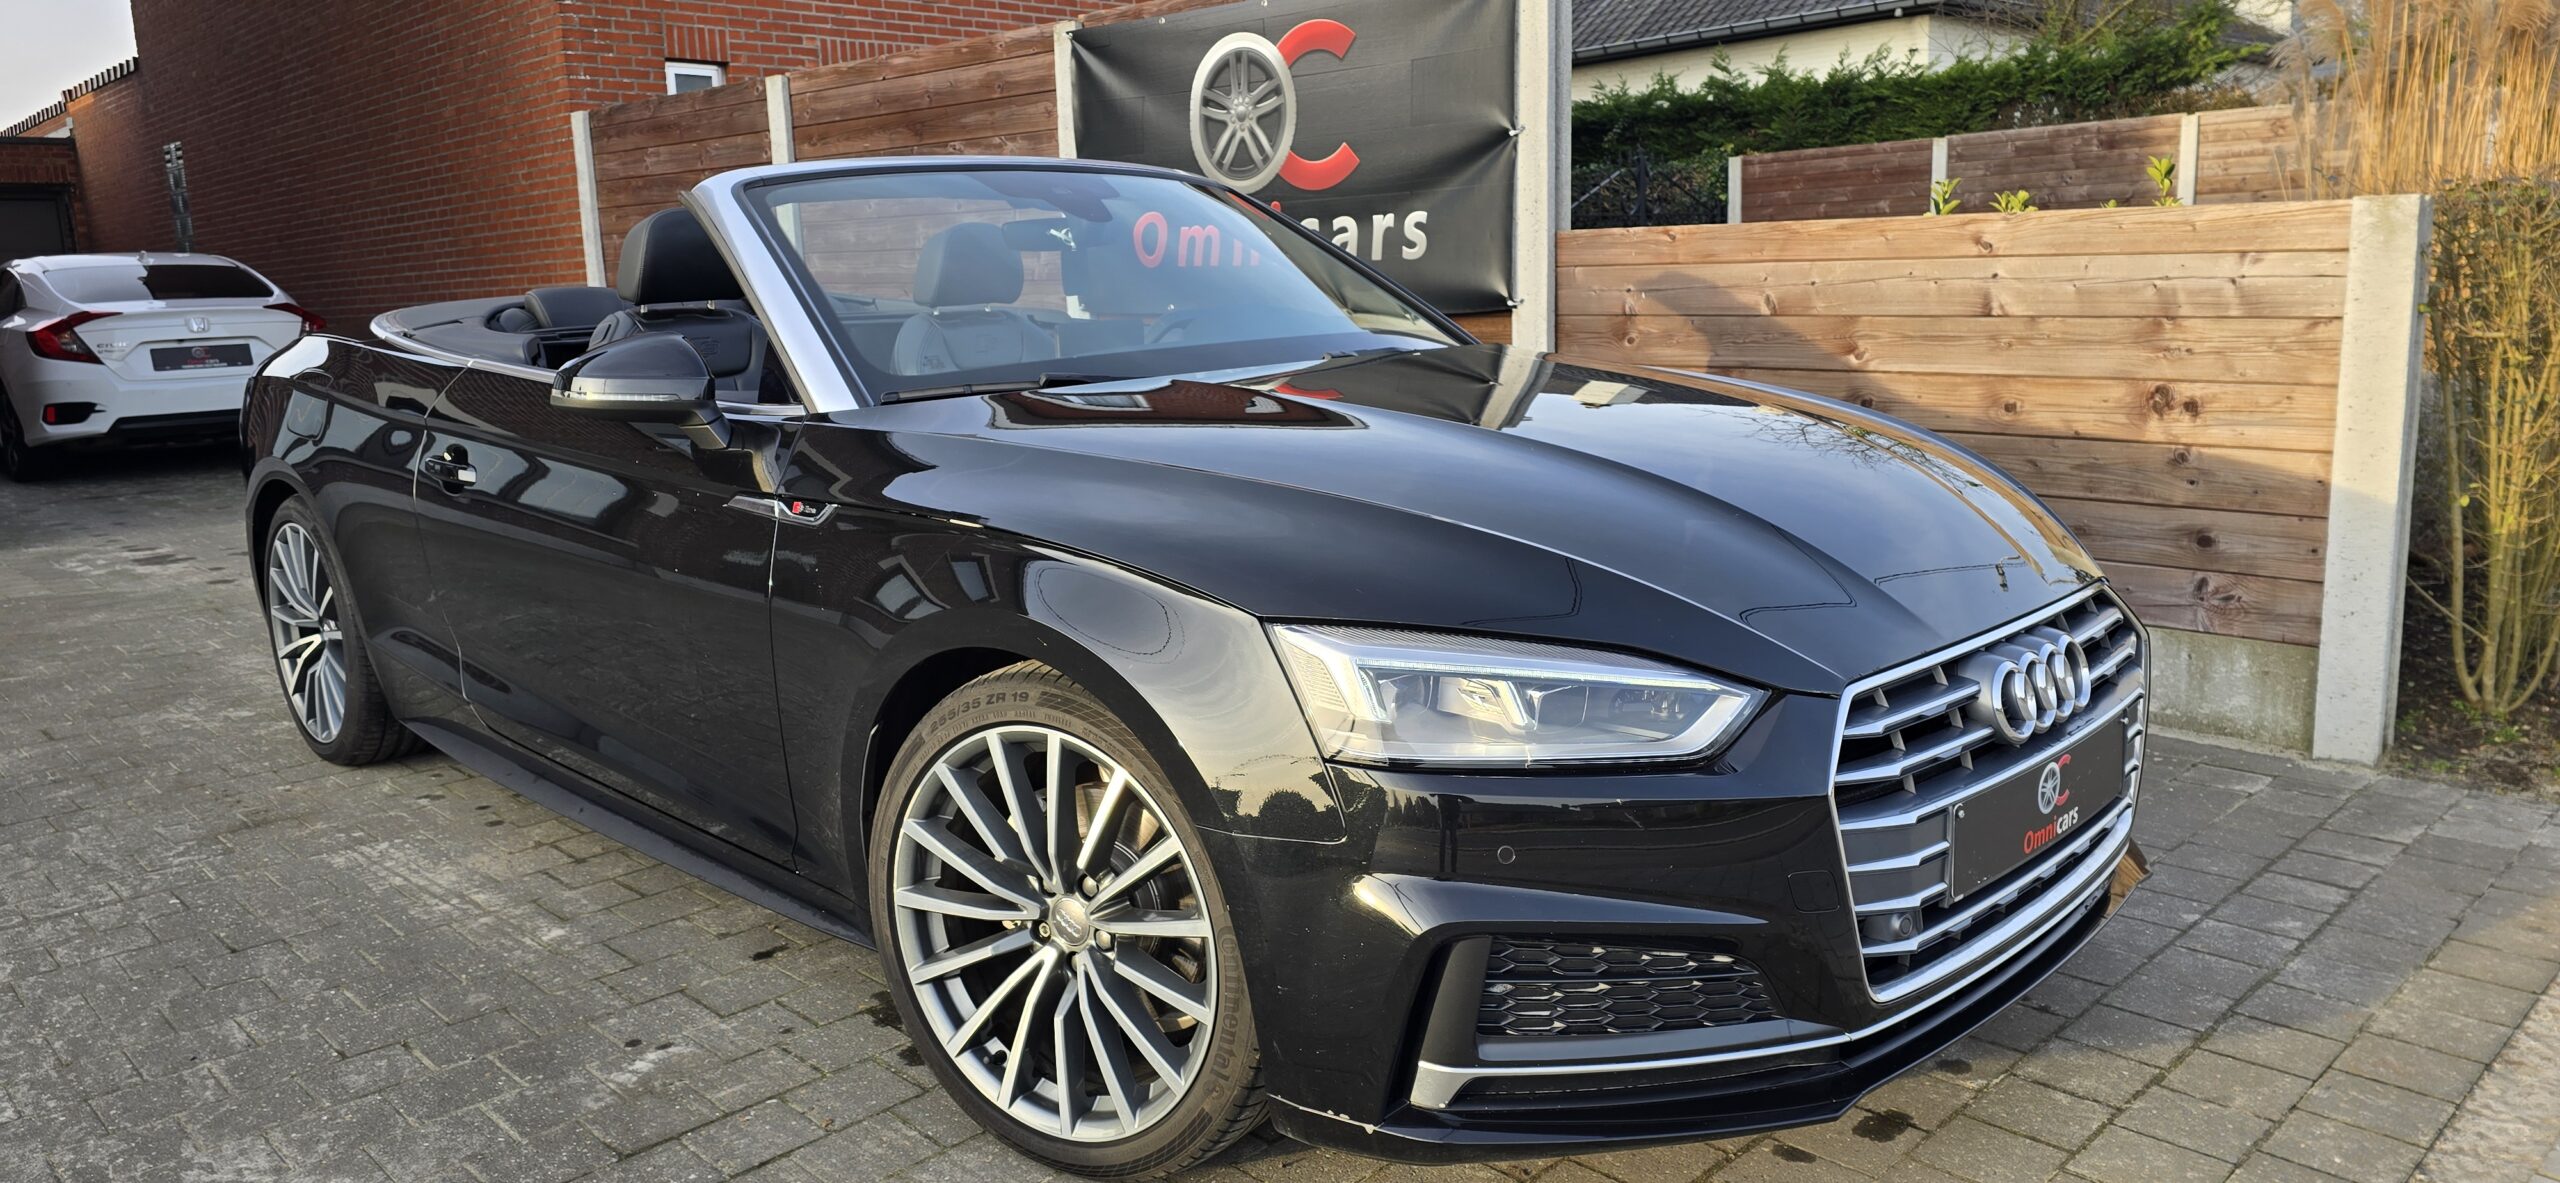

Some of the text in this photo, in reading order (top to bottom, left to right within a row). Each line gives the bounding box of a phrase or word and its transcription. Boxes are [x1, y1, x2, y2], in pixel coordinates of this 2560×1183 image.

[1132, 201, 1429, 269] Omars
[986, 692, 1006, 706] ZR
[1011, 691, 1029, 703] 19
[2023, 806, 2079, 854] Omnicars
